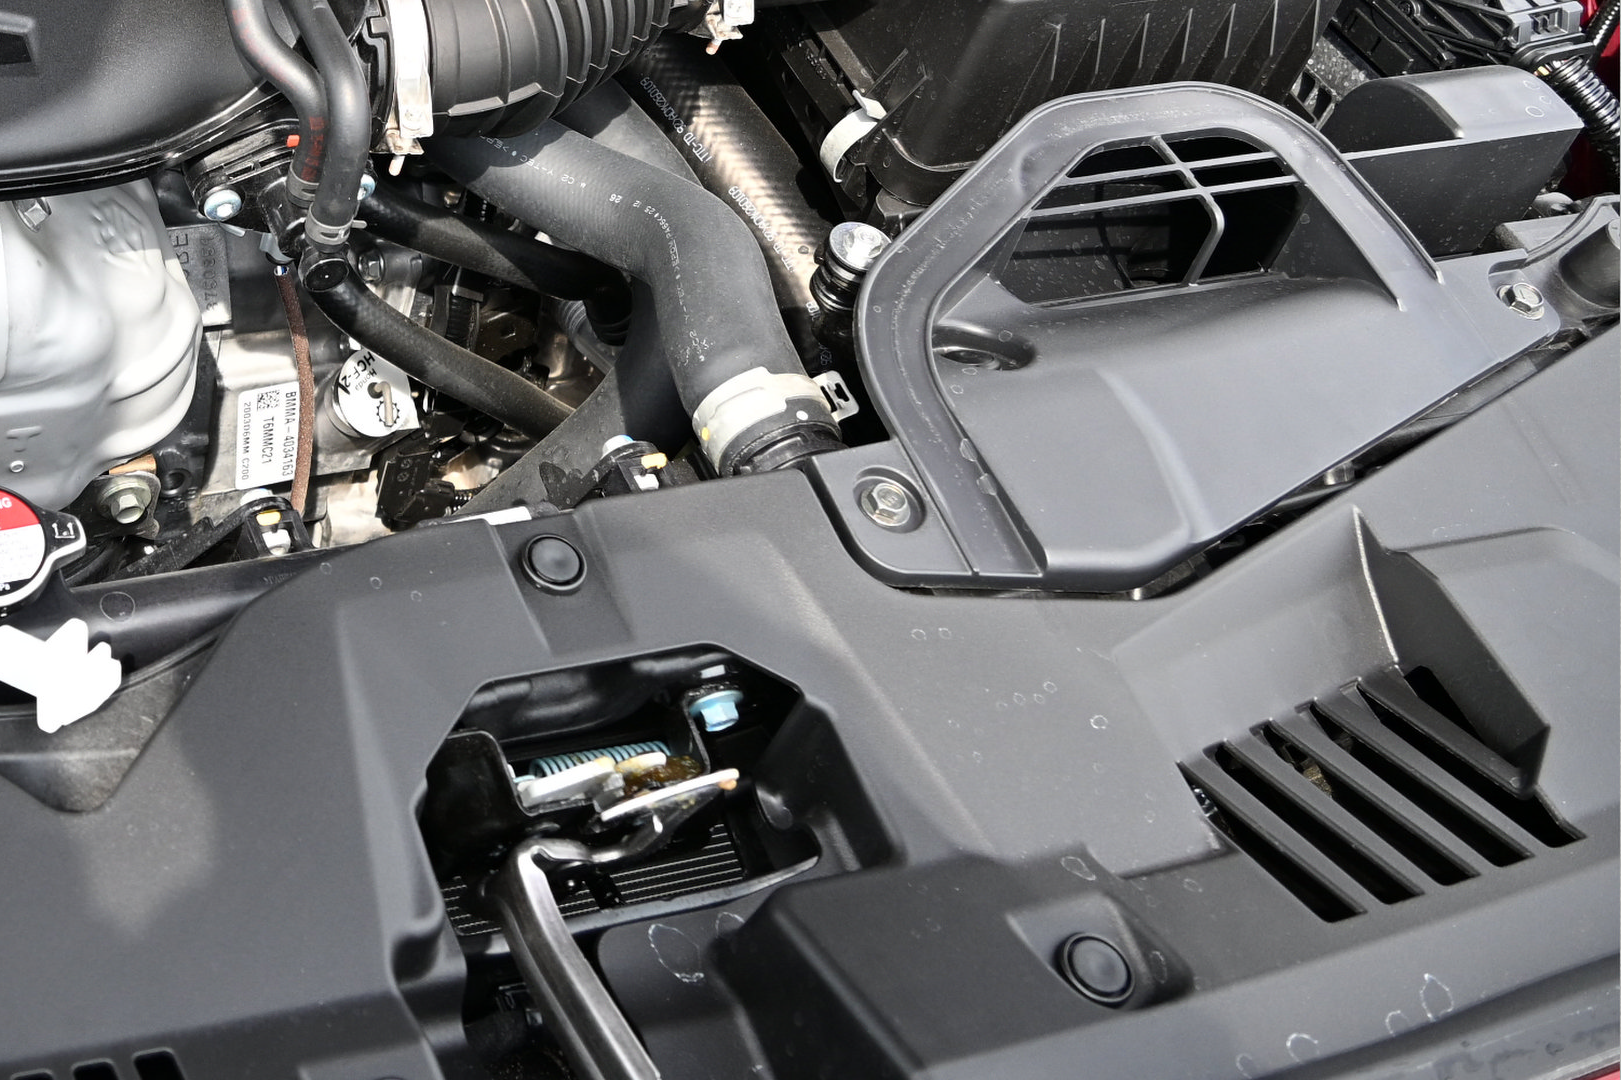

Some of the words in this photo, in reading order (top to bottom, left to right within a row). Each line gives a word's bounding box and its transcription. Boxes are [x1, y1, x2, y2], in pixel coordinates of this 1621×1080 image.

[561, 173, 575, 185] C2
[609, 192, 623, 204] 26
[340, 351, 376, 388] HCF-2
[354, 368, 378, 391] Honda
[261, 416, 274, 464] T6MMC21
